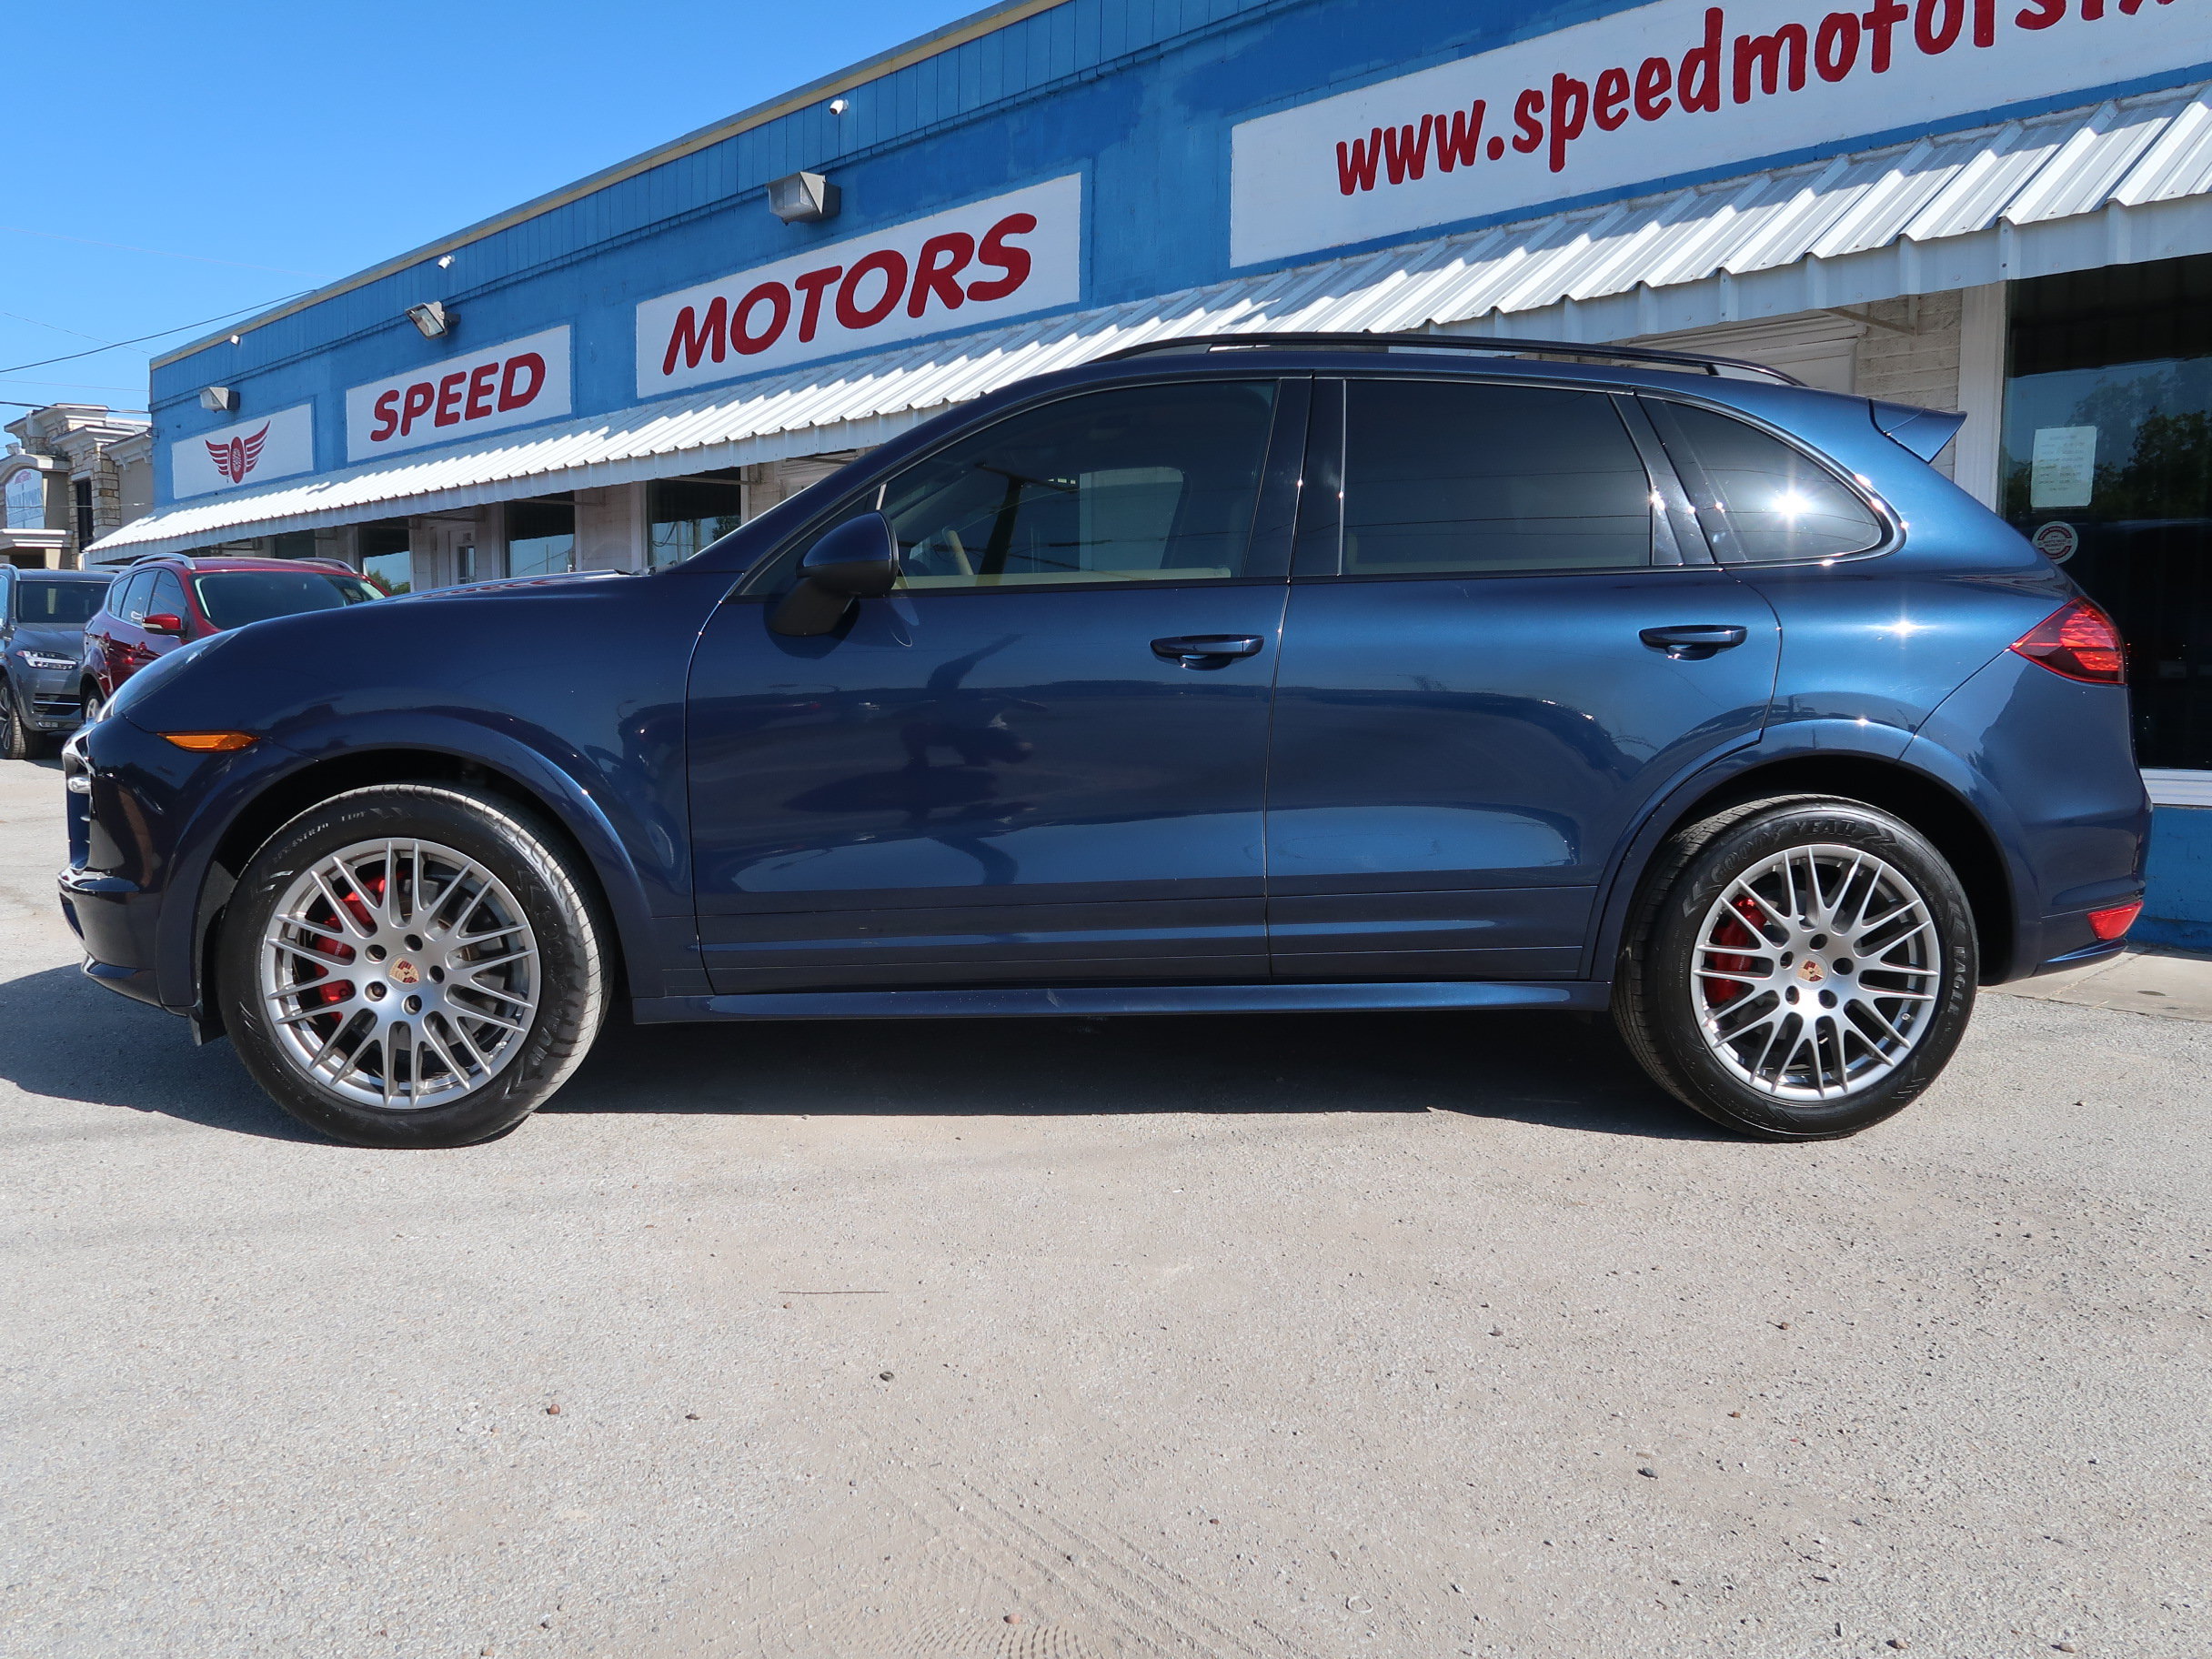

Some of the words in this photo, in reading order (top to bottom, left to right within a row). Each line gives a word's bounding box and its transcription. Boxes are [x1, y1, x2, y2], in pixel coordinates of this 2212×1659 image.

[1337, 0, 2176, 196] www.speedmotor
[371, 352, 546, 441] SPEED
[662, 212, 1038, 376] MOTORS
